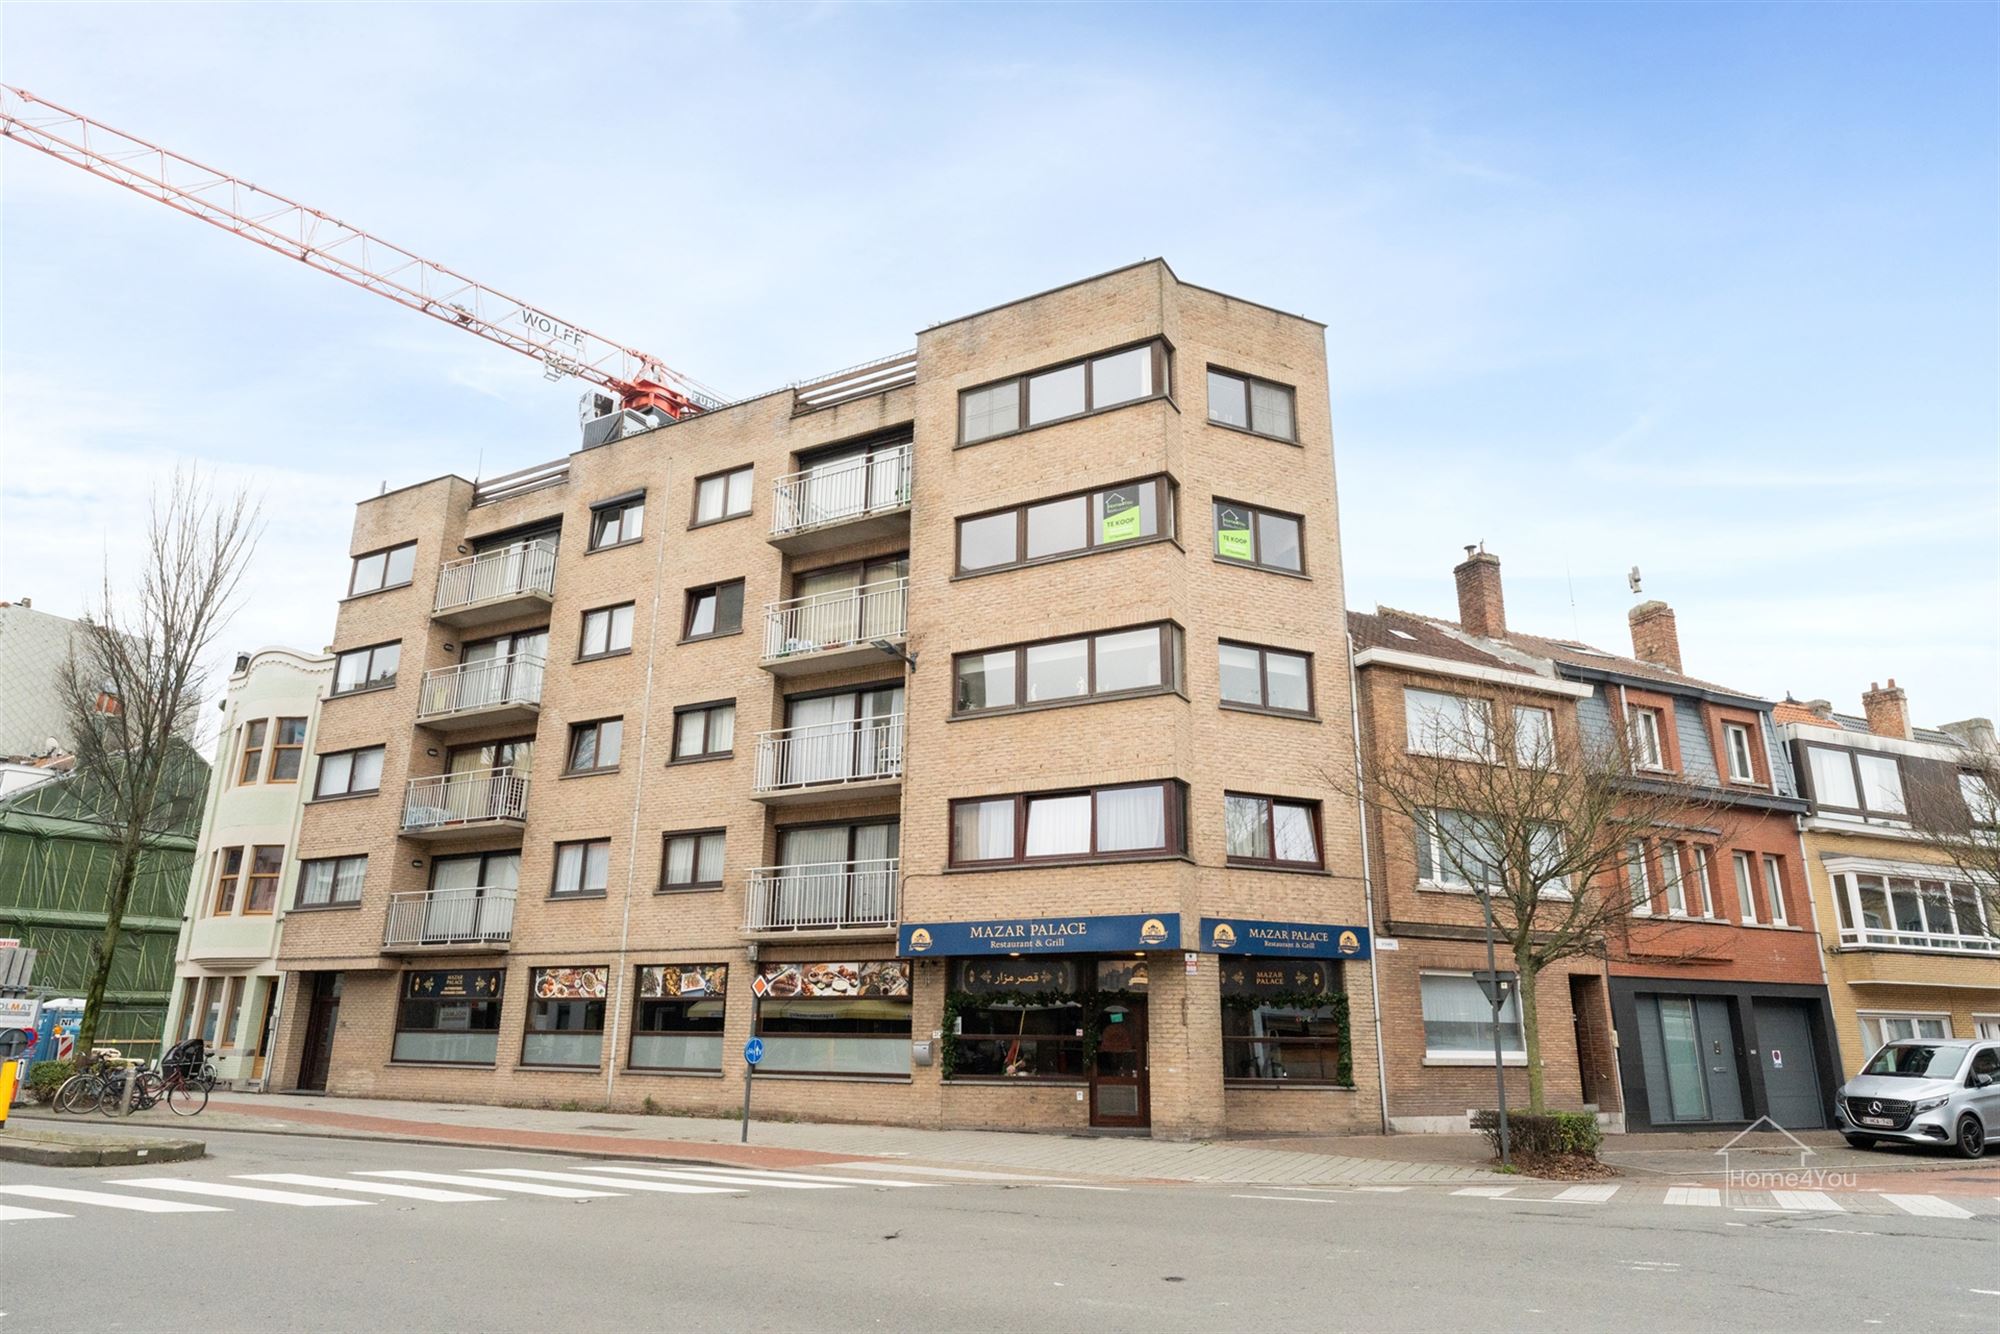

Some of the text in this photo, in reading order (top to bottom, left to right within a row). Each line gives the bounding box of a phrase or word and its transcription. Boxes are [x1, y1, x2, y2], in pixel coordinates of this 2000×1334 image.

[522, 309, 585, 346] WOLFF
[1115, 517, 1135, 526] KOOP
[1230, 537, 1248, 545] KOOP
[970, 922, 1087, 938] MAZAR PALACE
[1249, 928, 1329, 942] MAZAR PALACE
[990, 940, 1033, 949] Restaurant
[1045, 938, 1065, 947] Grill
[994, 972, 1040, 985] قصر مزار
